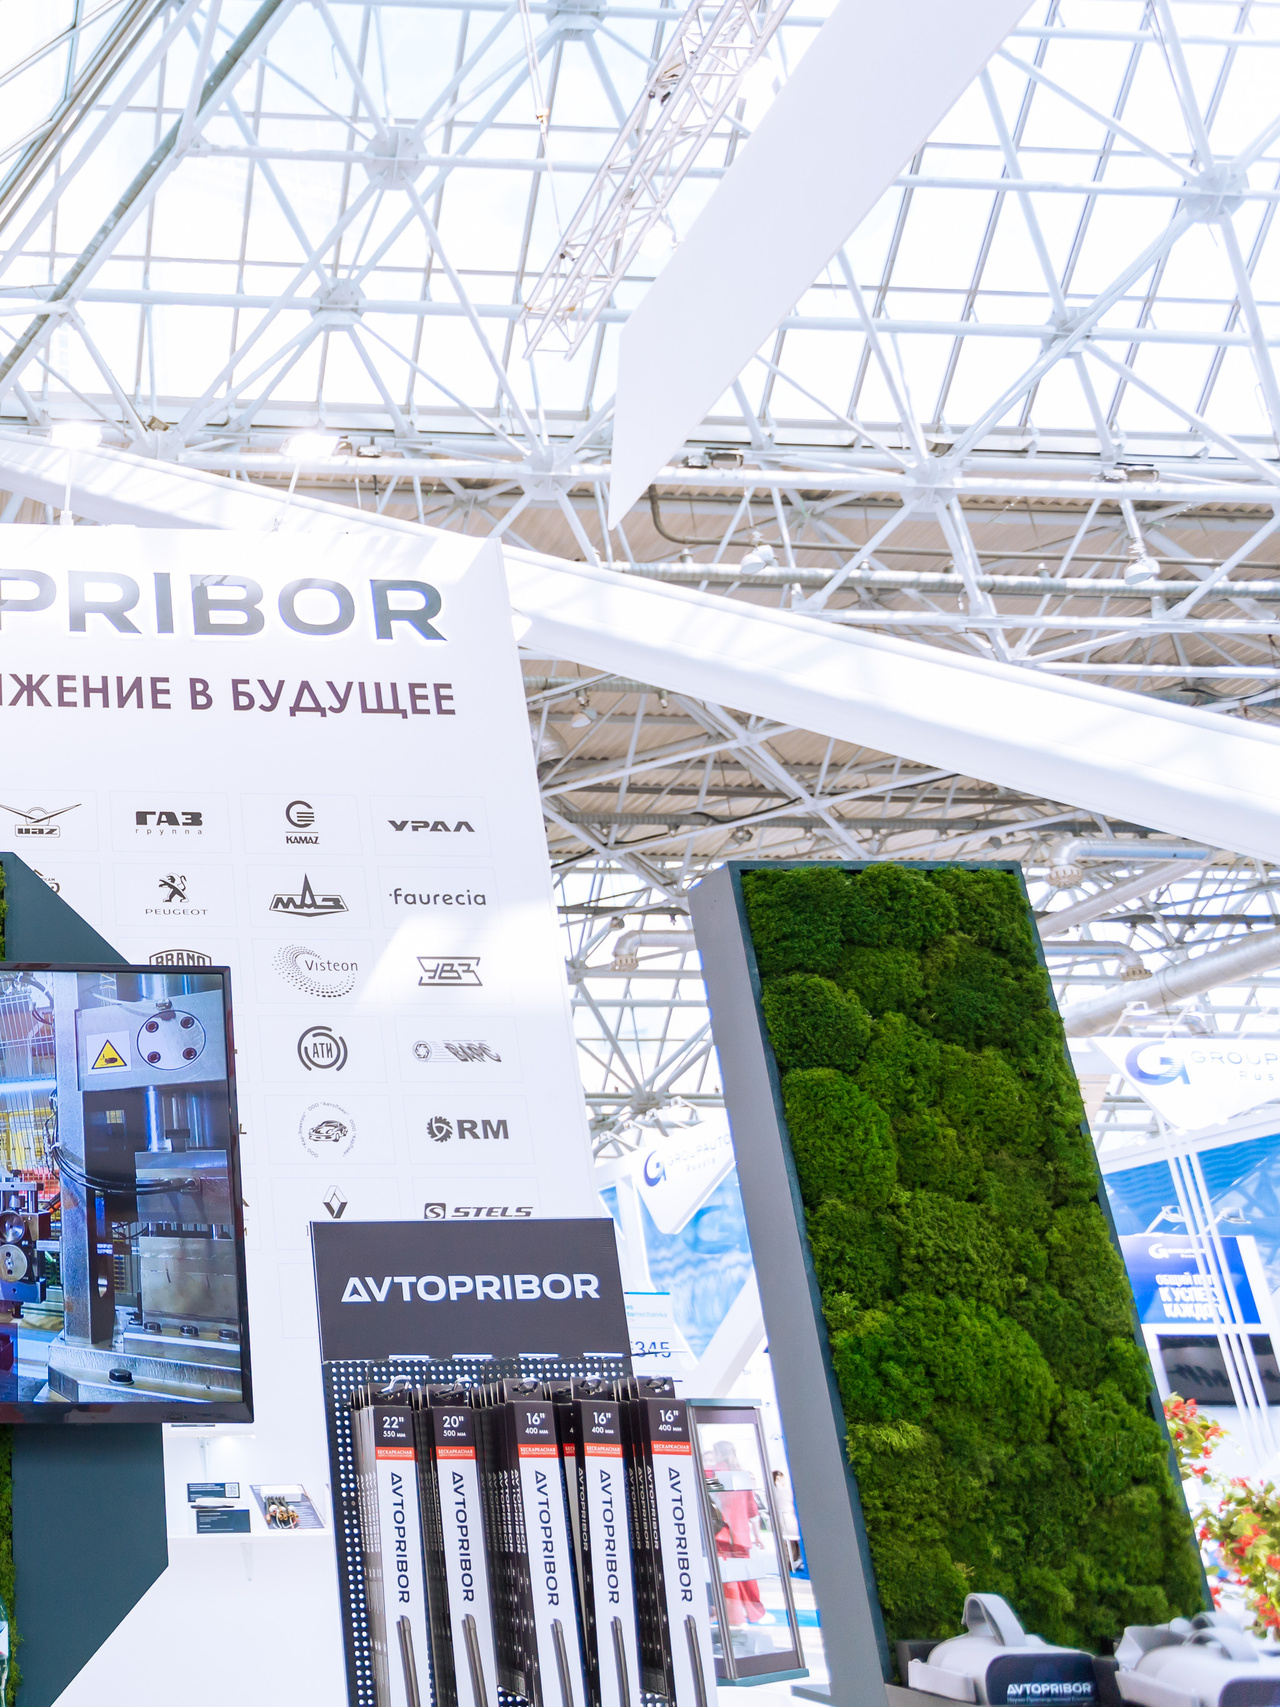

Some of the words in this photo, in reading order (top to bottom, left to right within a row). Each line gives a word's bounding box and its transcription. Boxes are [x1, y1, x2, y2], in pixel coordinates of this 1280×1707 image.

[189, 677, 213, 711] В
[231, 678, 456, 720] БУДУЩЕЕ
[135, 810, 203, 827] ГАЗ
[135, 828, 203, 836] группа
[387, 820, 476, 833] УРАЛ
[285, 835, 320, 844] KAMAZ
[392, 887, 487, 906] faurecia
[145, 908, 209, 916] PEUGEOT
[304, 958, 359, 972] Visteon
[455, 1119, 510, 1140] RM
[451, 1206, 534, 1218] STELS
[340, 1273, 601, 1303] AVTOPRIBOR
[631, 1341, 671, 1358] 345
[442, 1415, 464, 1428] 20"
[526, 1412, 546, 1425] 16"
[593, 1412, 612, 1425] 16"
[659, 1409, 679, 1422] 16"
[382, 1416, 404, 1429] 22"
[658, 1424, 672, 1432] 400
[382, 1430, 396, 1438] 550
[525, 1427, 538, 1435] 400
[591, 1426, 604, 1434] 400
[578, 1466, 589, 1552] AVTOPRIBOR
[646, 1465, 660, 1550] AVTOPRIBOR
[390, 1471, 410, 1603] AVTOPRIBOR
[451, 1471, 475, 1602] AVTOPRIBOR
[534, 1469, 560, 1607] AVTOPRIBOR
[600, 1468, 620, 1605] AVTOPRIBOR
[668, 1467, 693, 1603] AVTOPRIBOR
[1006, 1682, 1092, 1695] AVTOPRIBOR
